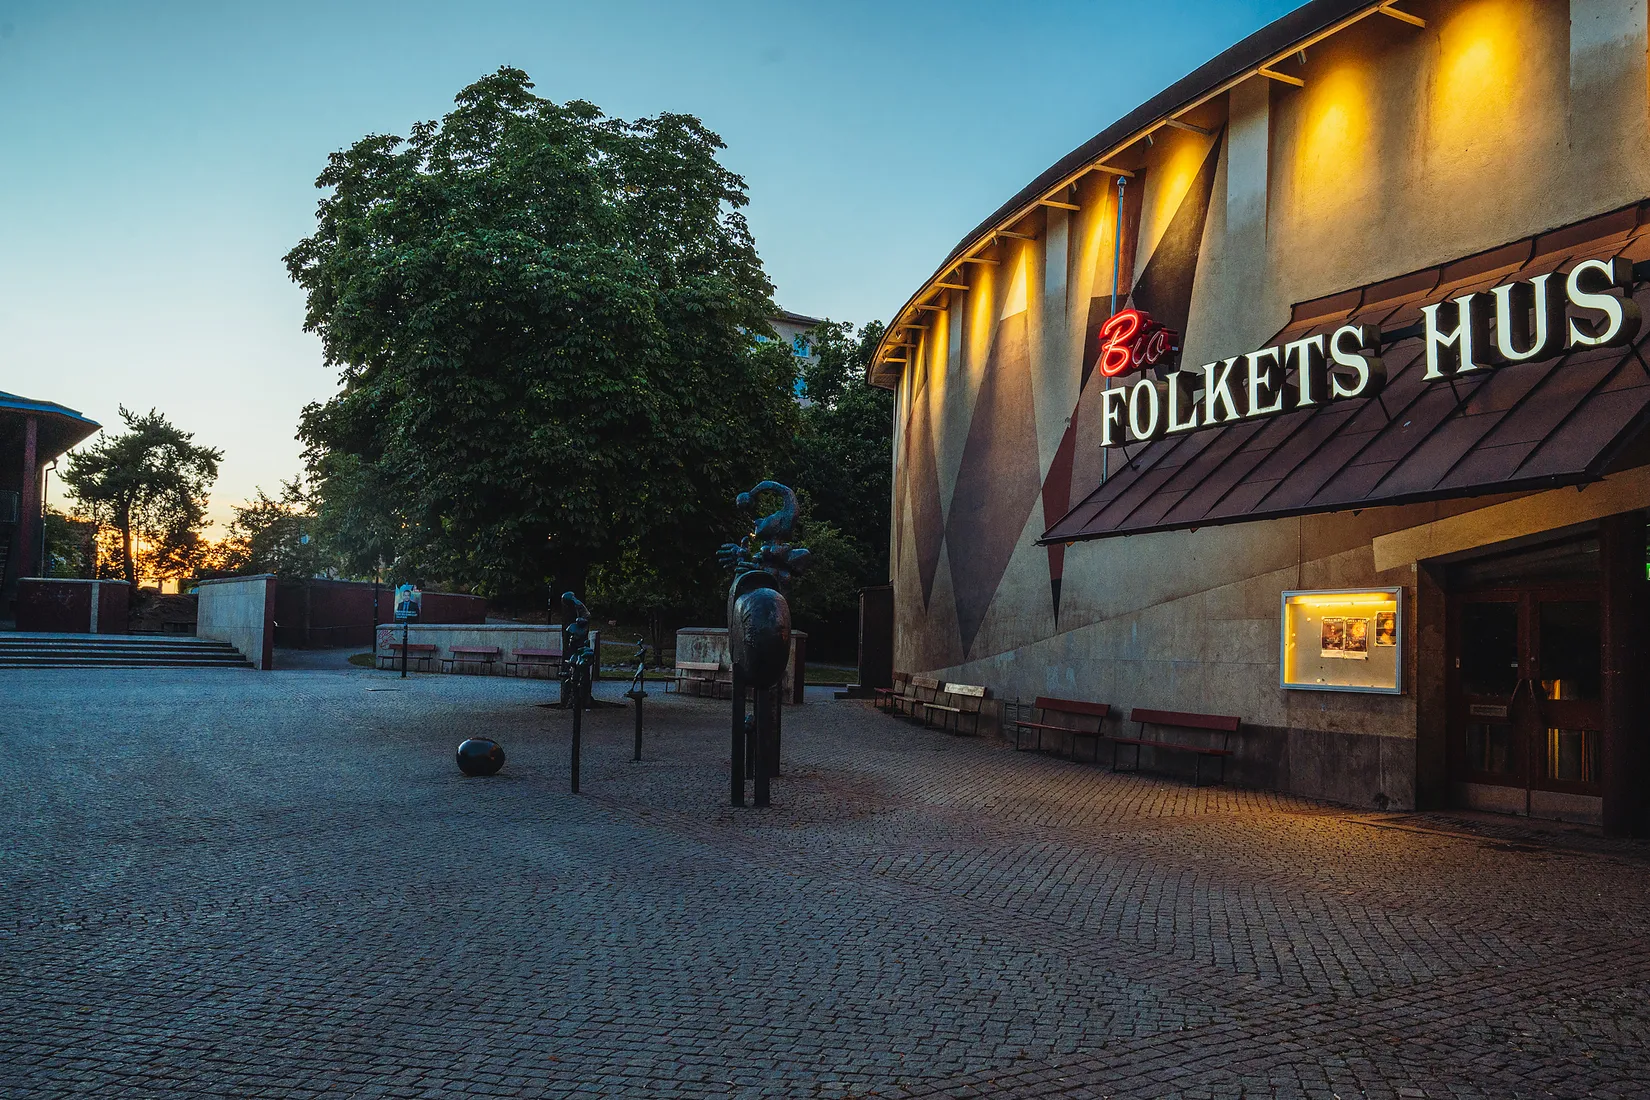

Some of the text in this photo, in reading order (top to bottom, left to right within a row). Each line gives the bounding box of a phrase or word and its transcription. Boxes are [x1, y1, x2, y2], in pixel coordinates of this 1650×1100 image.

[1099, 309, 1168, 377] Bio
[1099, 258, 1624, 447] FOLKETS HUS
